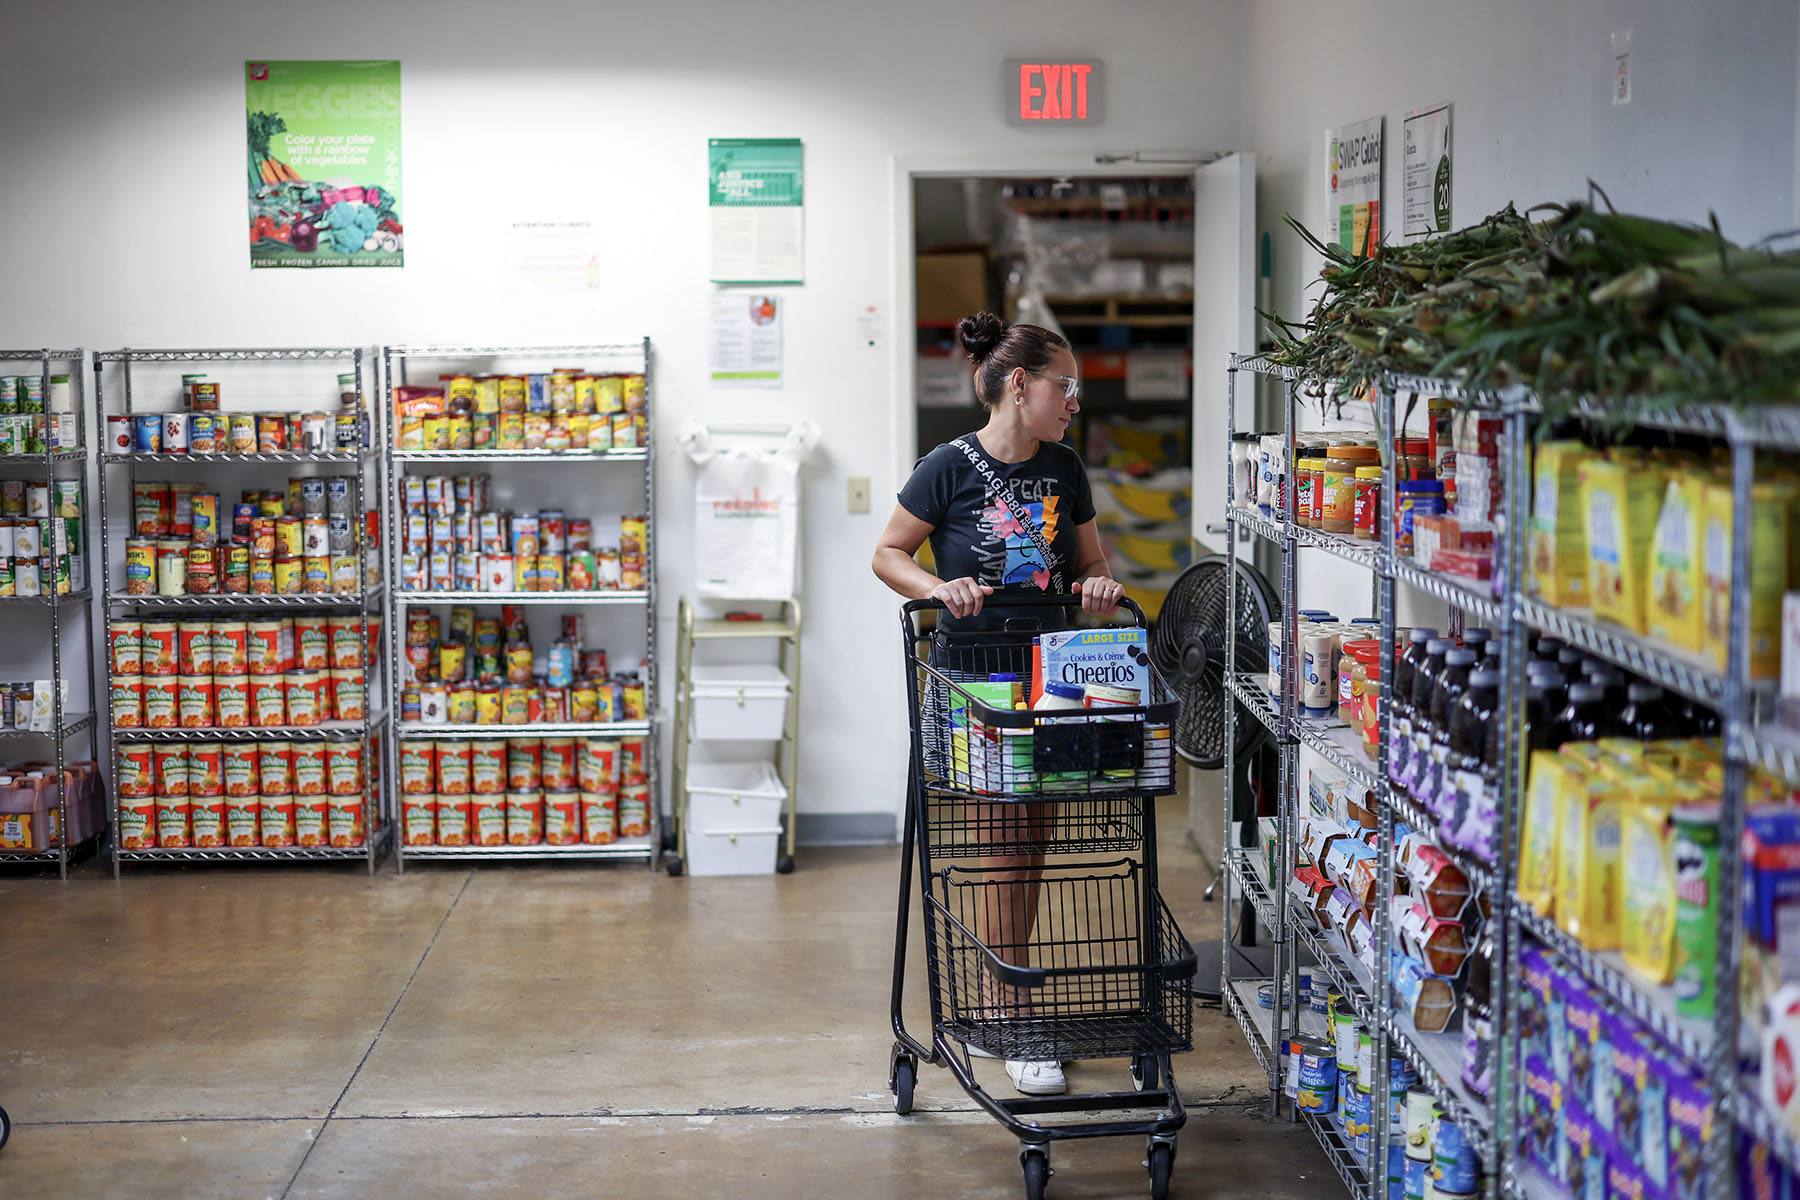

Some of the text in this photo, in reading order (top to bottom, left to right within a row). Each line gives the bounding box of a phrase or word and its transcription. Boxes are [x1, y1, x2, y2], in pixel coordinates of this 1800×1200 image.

[1020, 64, 1092, 120] EXIT
[285, 134, 376, 149] Color your plate
[288, 145, 312, 155] with
[324, 144, 370, 155] rainbow
[1361, 133, 1380, 166] Guid
[290, 155, 367, 167] of vegetables
[1438, 183, 1449, 211] 20
[252, 258, 278, 267] FRESH
[281, 258, 313, 267] FROZEN
[1081, 632, 1139, 644] LARGE SIZE
[1070, 653, 1097, 662] Cookies
[1097, 653, 1104, 661] &
[1062, 661, 1135, 684] Cheerios
